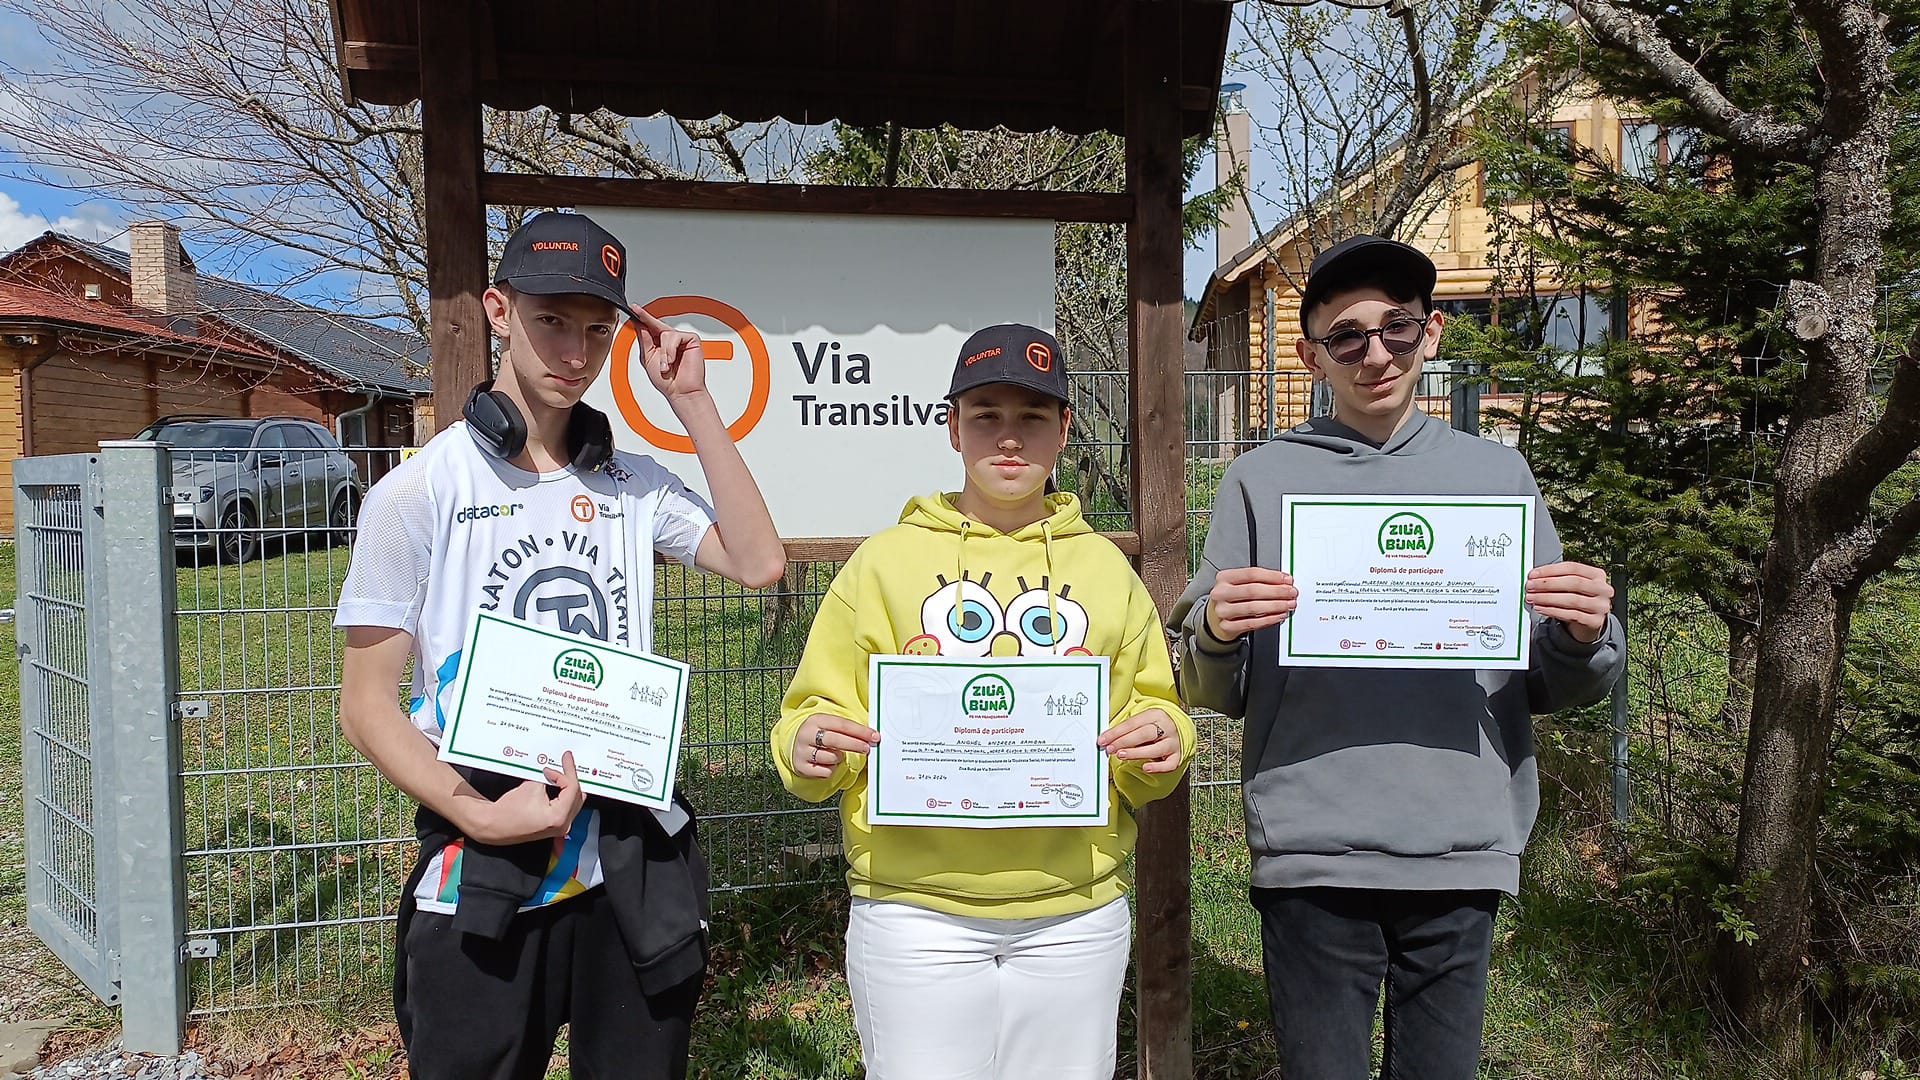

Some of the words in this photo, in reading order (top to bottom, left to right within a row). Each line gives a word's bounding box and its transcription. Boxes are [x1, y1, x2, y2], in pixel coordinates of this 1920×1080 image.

[532, 241, 579, 252] VOLUNTAR
[792, 341, 871, 384] Via
[965, 347, 1001, 367] VOLUNTAR
[793, 395, 950, 426] Transilva
[1389, 523, 1424, 536] ZIUA
[562, 530, 599, 566] VIA
[1369, 566, 1397, 575] Diplomă
[1408, 567, 1444, 575] participare
[564, 656, 595, 671] ZIUA
[542, 686, 568, 698] Diplomă
[577, 695, 609, 708] participare
[972, 684, 1006, 697] ZIUA
[954, 726, 981, 735] Diplomă
[991, 727, 1025, 736] participare
